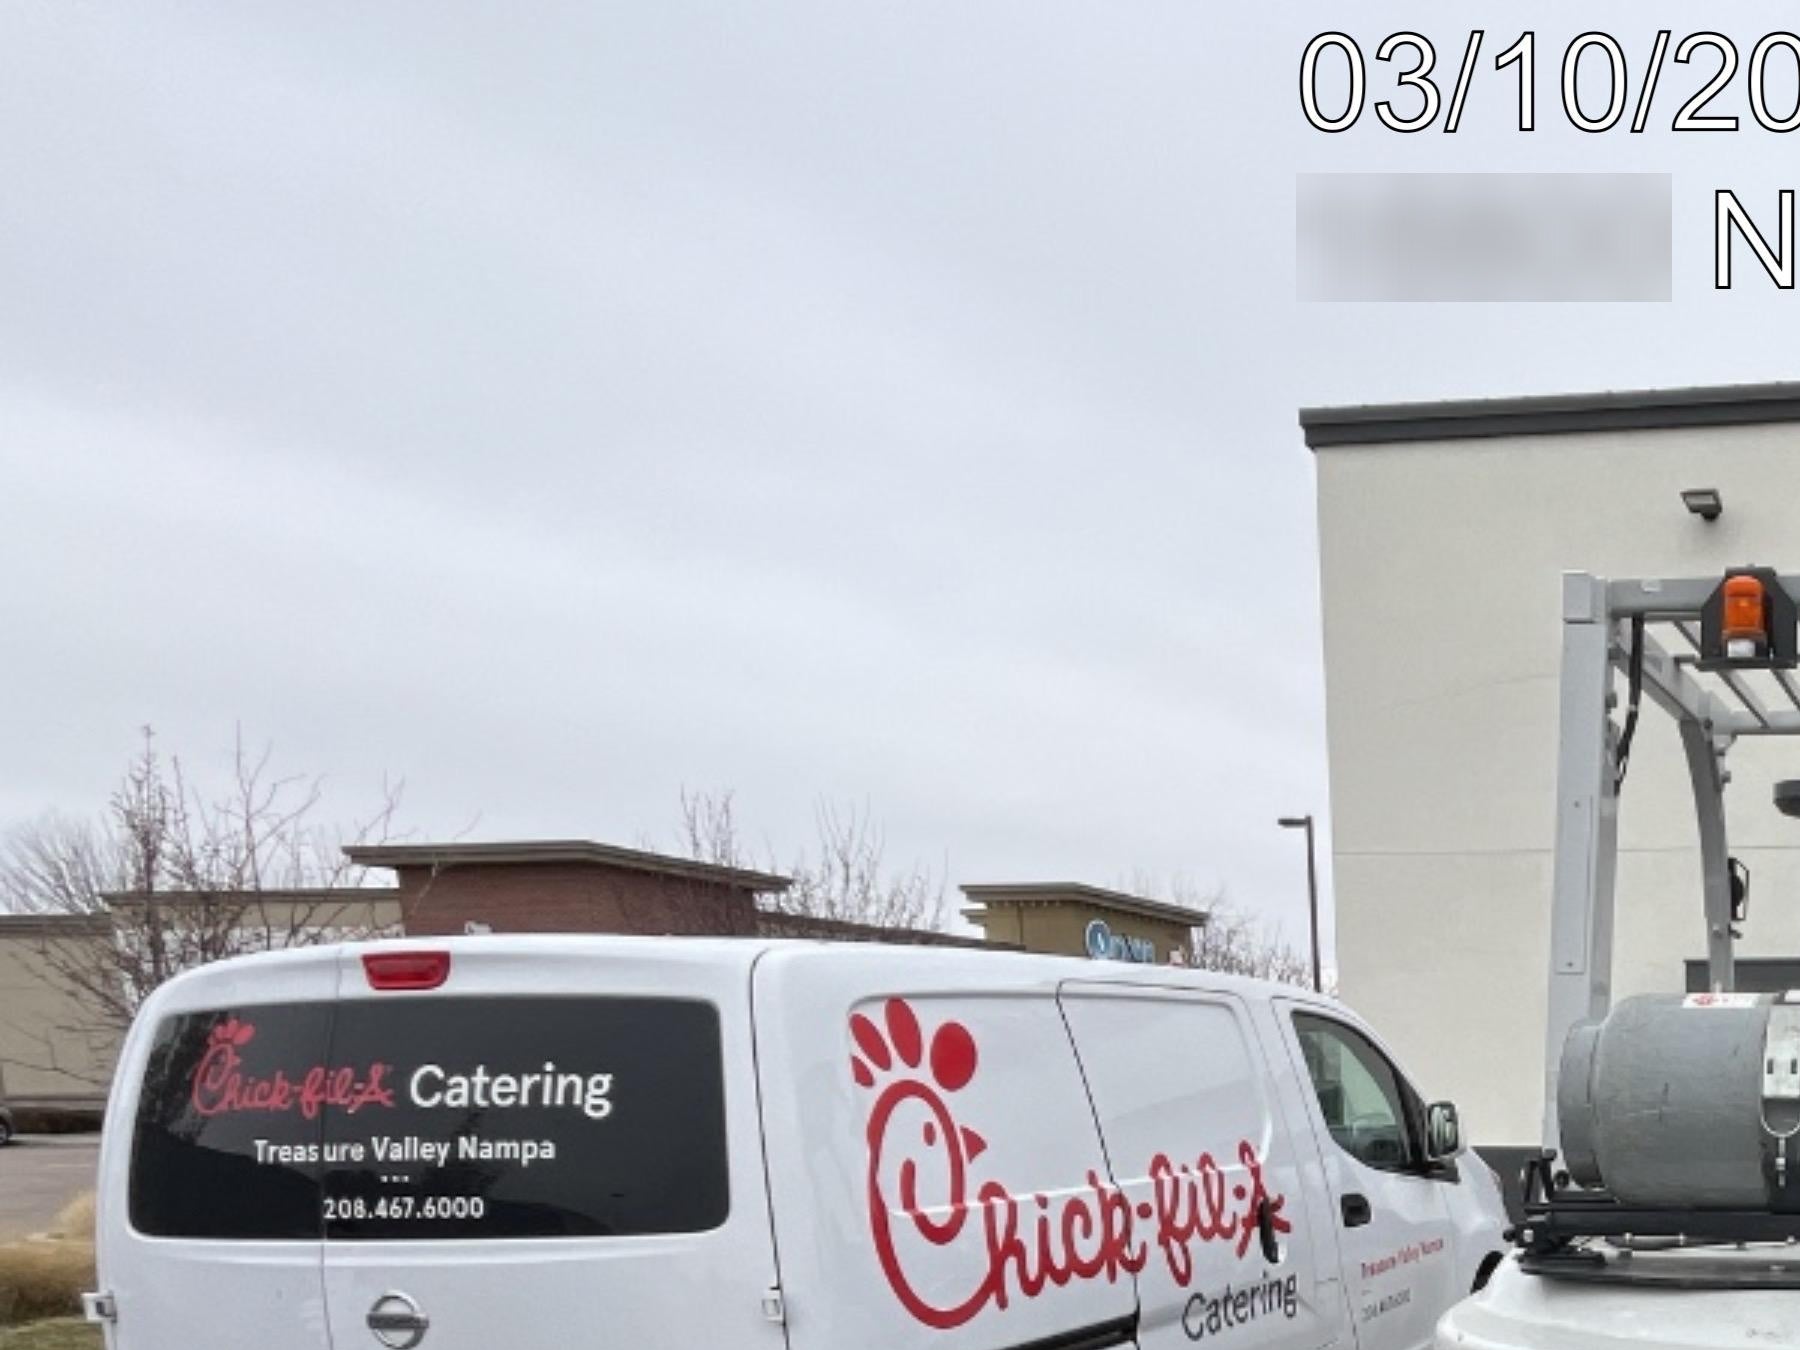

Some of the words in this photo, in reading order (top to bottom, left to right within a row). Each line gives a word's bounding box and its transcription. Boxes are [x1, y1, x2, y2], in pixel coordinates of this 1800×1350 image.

[192, 1043, 396, 1120] Chick-fil-A
[409, 1062, 615, 1119] Catering
[253, 1138, 364, 1165] Treasure
[371, 1135, 450, 1168] Valley
[457, 1135, 556, 1168] Nampa
[323, 1195, 485, 1220] 208.467.6000
[866, 1079, 1293, 1330] Chick-fil-A
[1181, 1270, 1298, 1342] Catering
